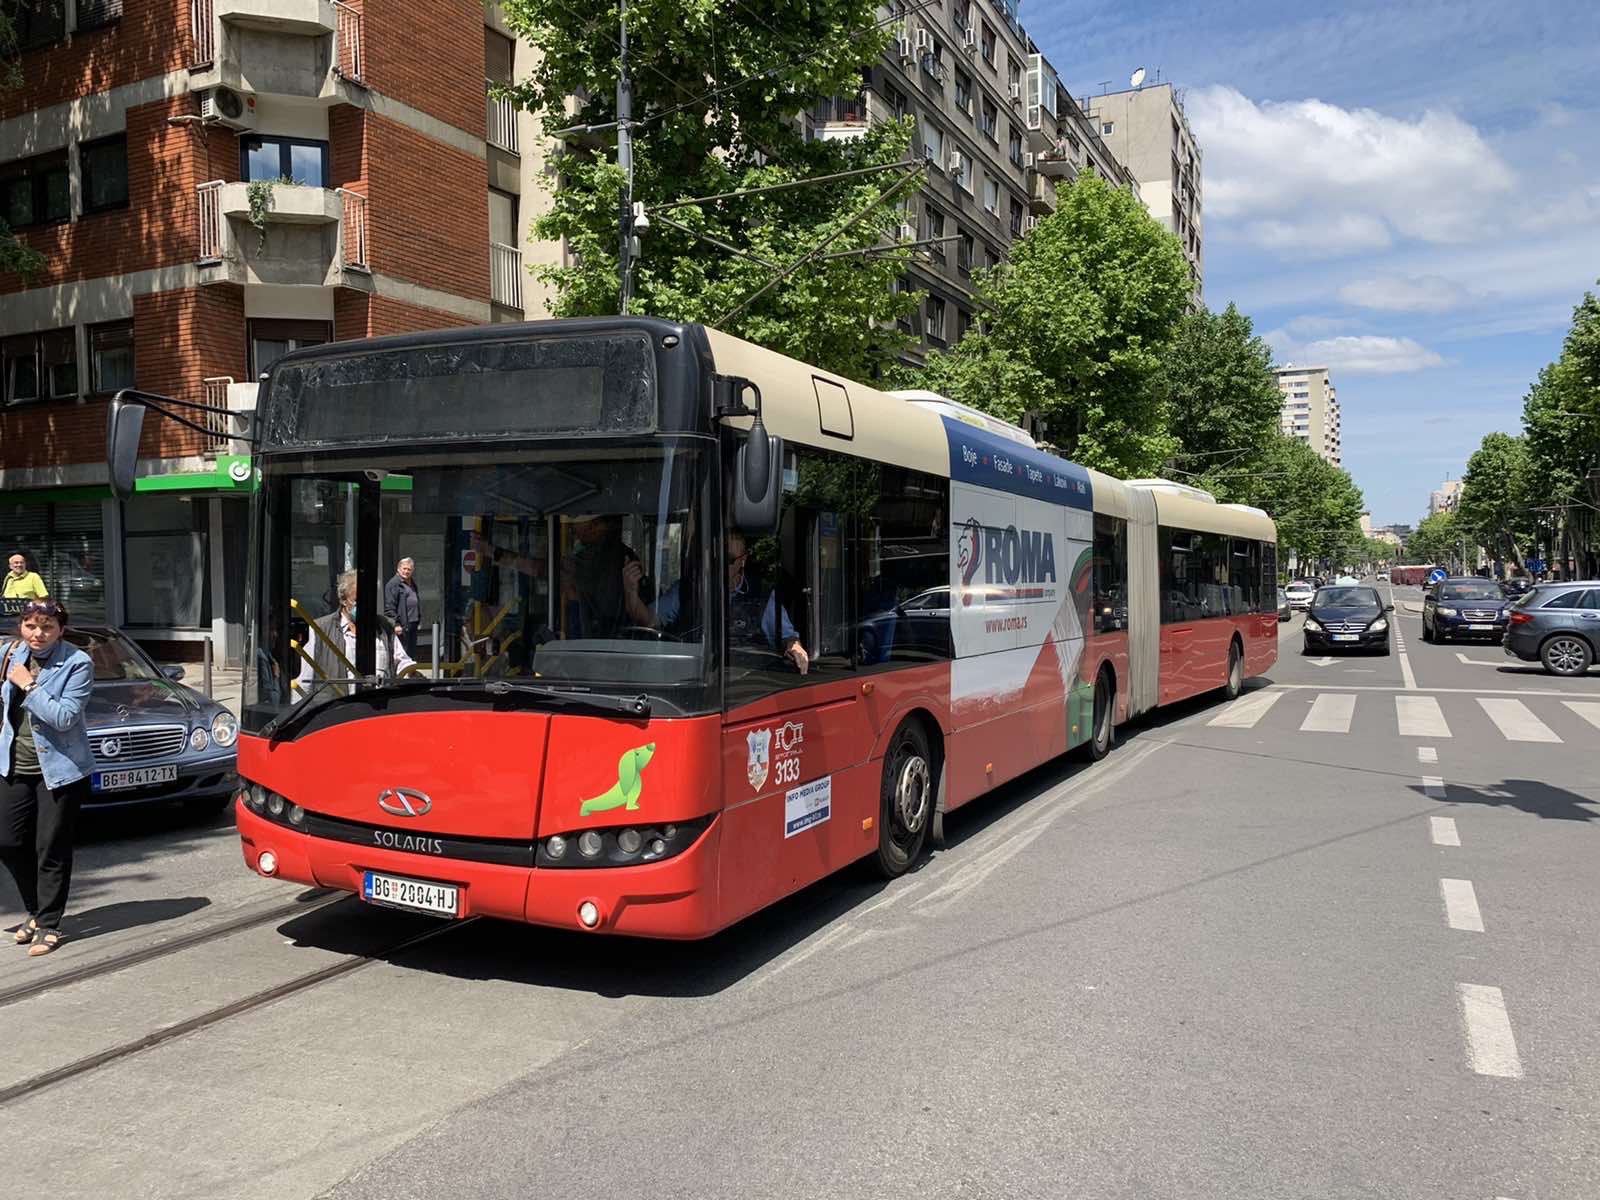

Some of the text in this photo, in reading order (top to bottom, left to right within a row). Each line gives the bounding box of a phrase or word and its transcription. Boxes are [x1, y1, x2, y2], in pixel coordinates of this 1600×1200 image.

[985, 524, 1057, 585] ROMA
[985, 616, 1027, 633] www.roma.rs
[103, 774, 119, 787] BG
[775, 757, 800, 785] 3133
[787, 791, 799, 802] INFO
[800, 786, 814, 797] MEDIA
[815, 780, 830, 792] GROUP
[374, 831, 442, 854] SOLARIS
[374, 878, 390, 898] BG
